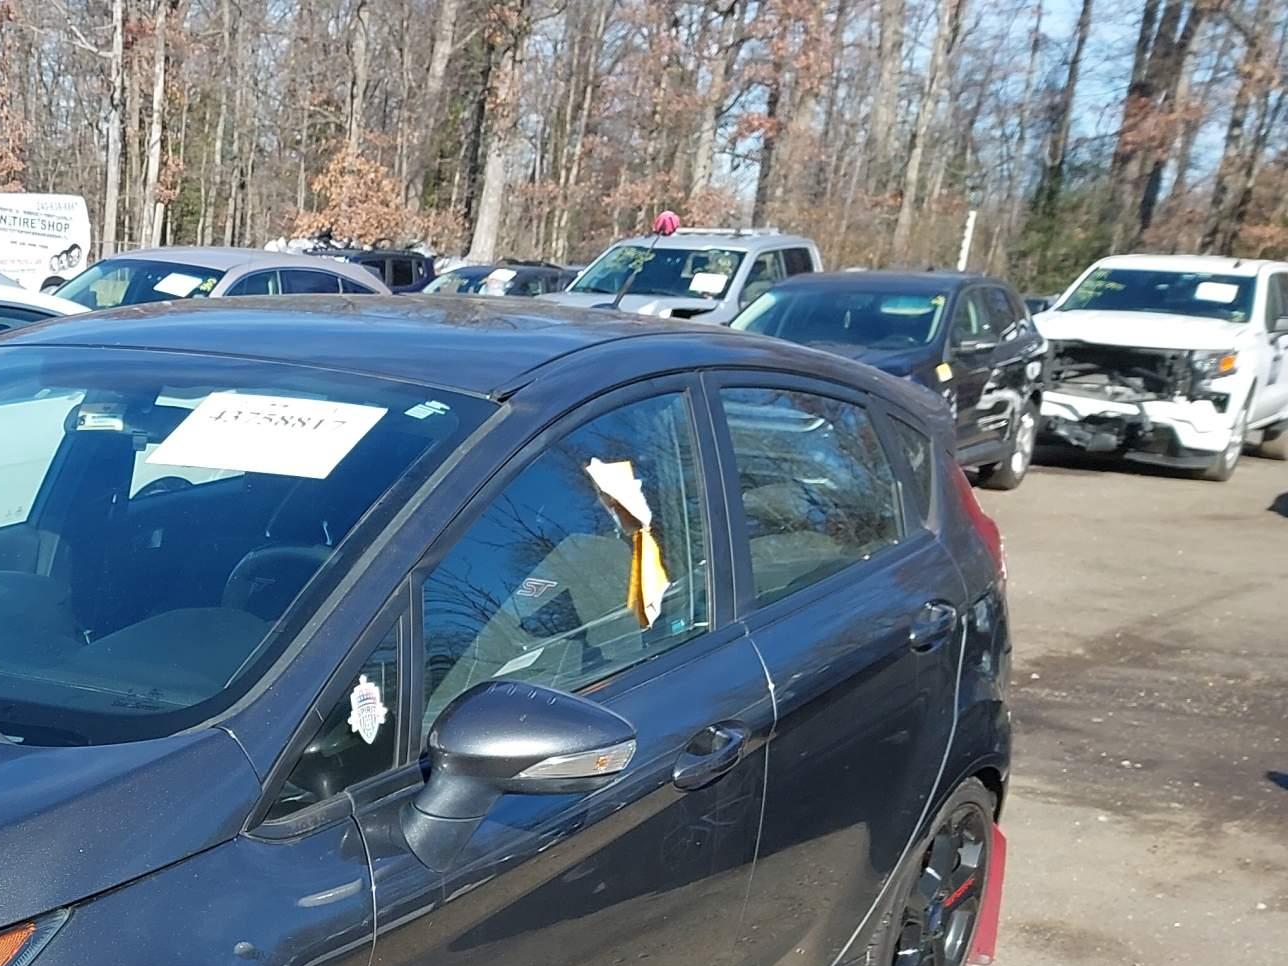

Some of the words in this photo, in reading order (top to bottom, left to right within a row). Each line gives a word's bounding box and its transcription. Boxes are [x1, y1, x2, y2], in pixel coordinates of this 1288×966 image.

[12, 216, 38, 229] TIRE
[41, 220, 70, 233] SHOP
[516, 577, 558, 597] ST
